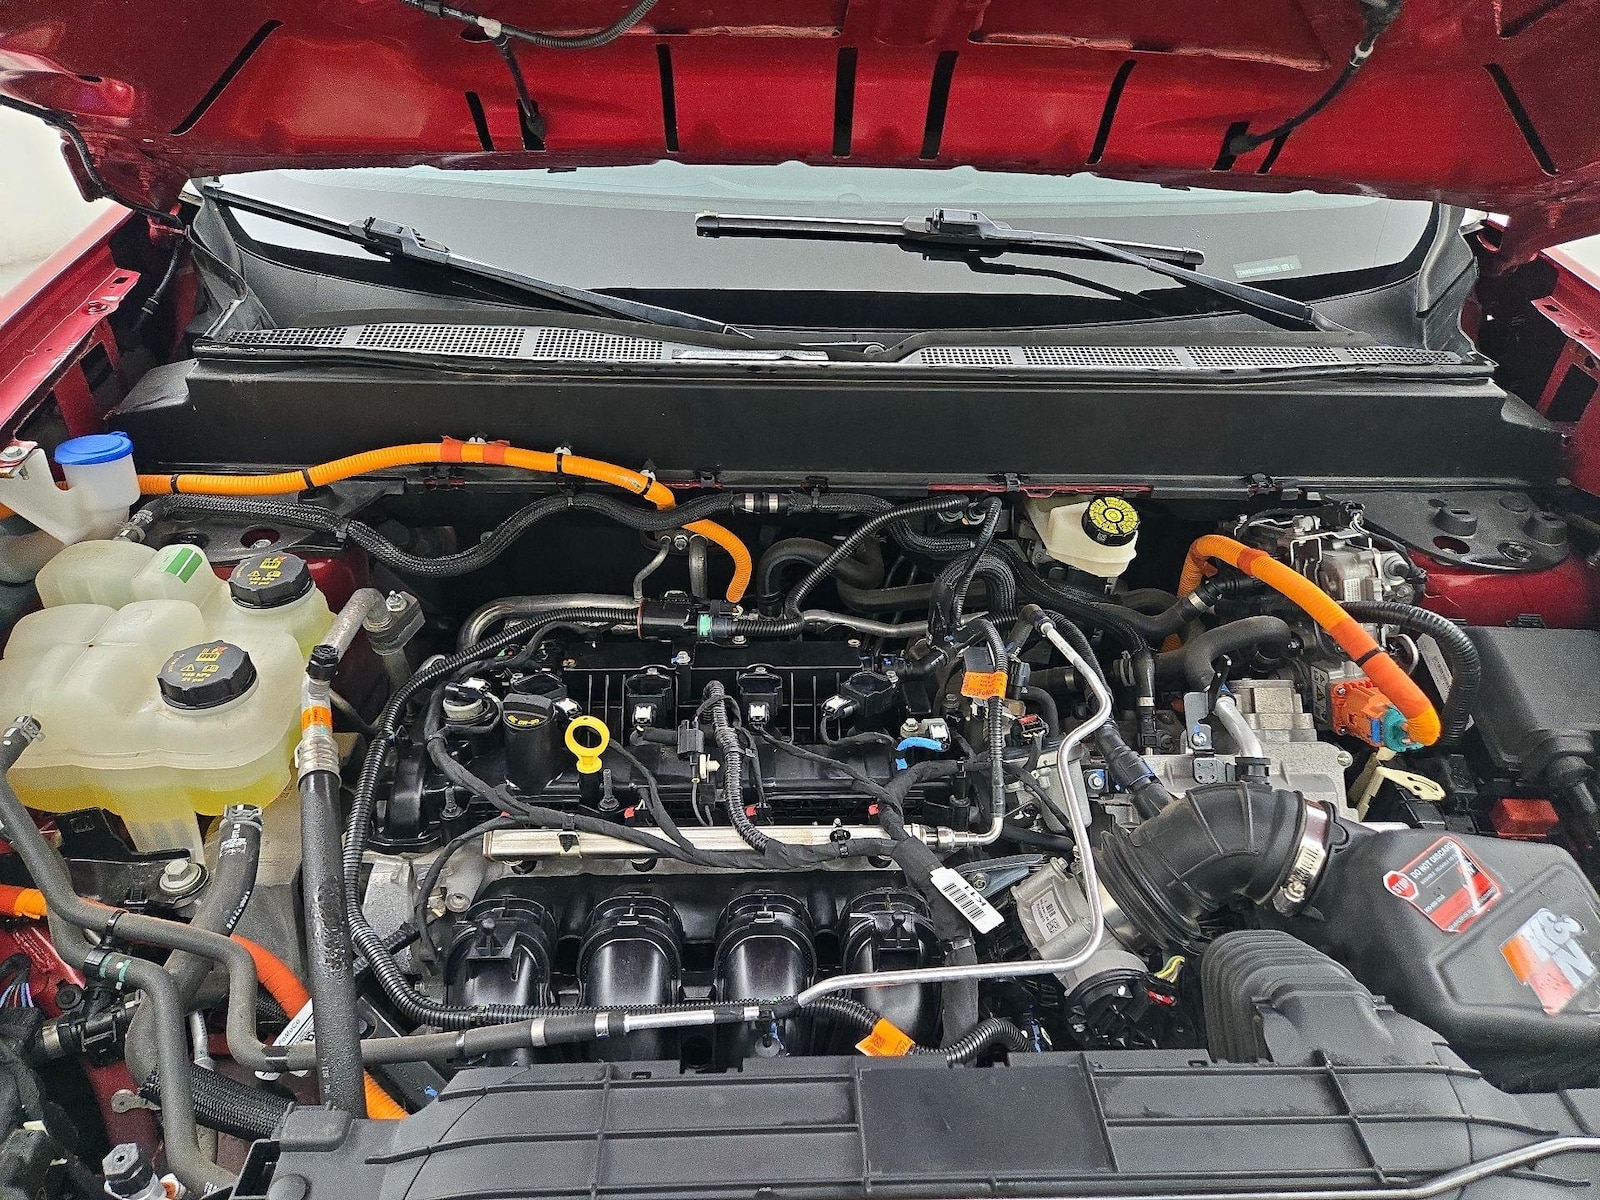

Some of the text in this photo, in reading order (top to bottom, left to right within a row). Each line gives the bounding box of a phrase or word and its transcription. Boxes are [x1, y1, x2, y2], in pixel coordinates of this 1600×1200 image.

[1410, 868, 1422, 879] DO
[1418, 859, 1432, 872] NOT
[1429, 841, 1455, 863] DISCARD
[964, 885, 987, 907] K11
[1391, 877, 1410, 895] STOP
[1519, 908, 1596, 990] K&N
[278, 1018, 300, 1045] FoMoCo
